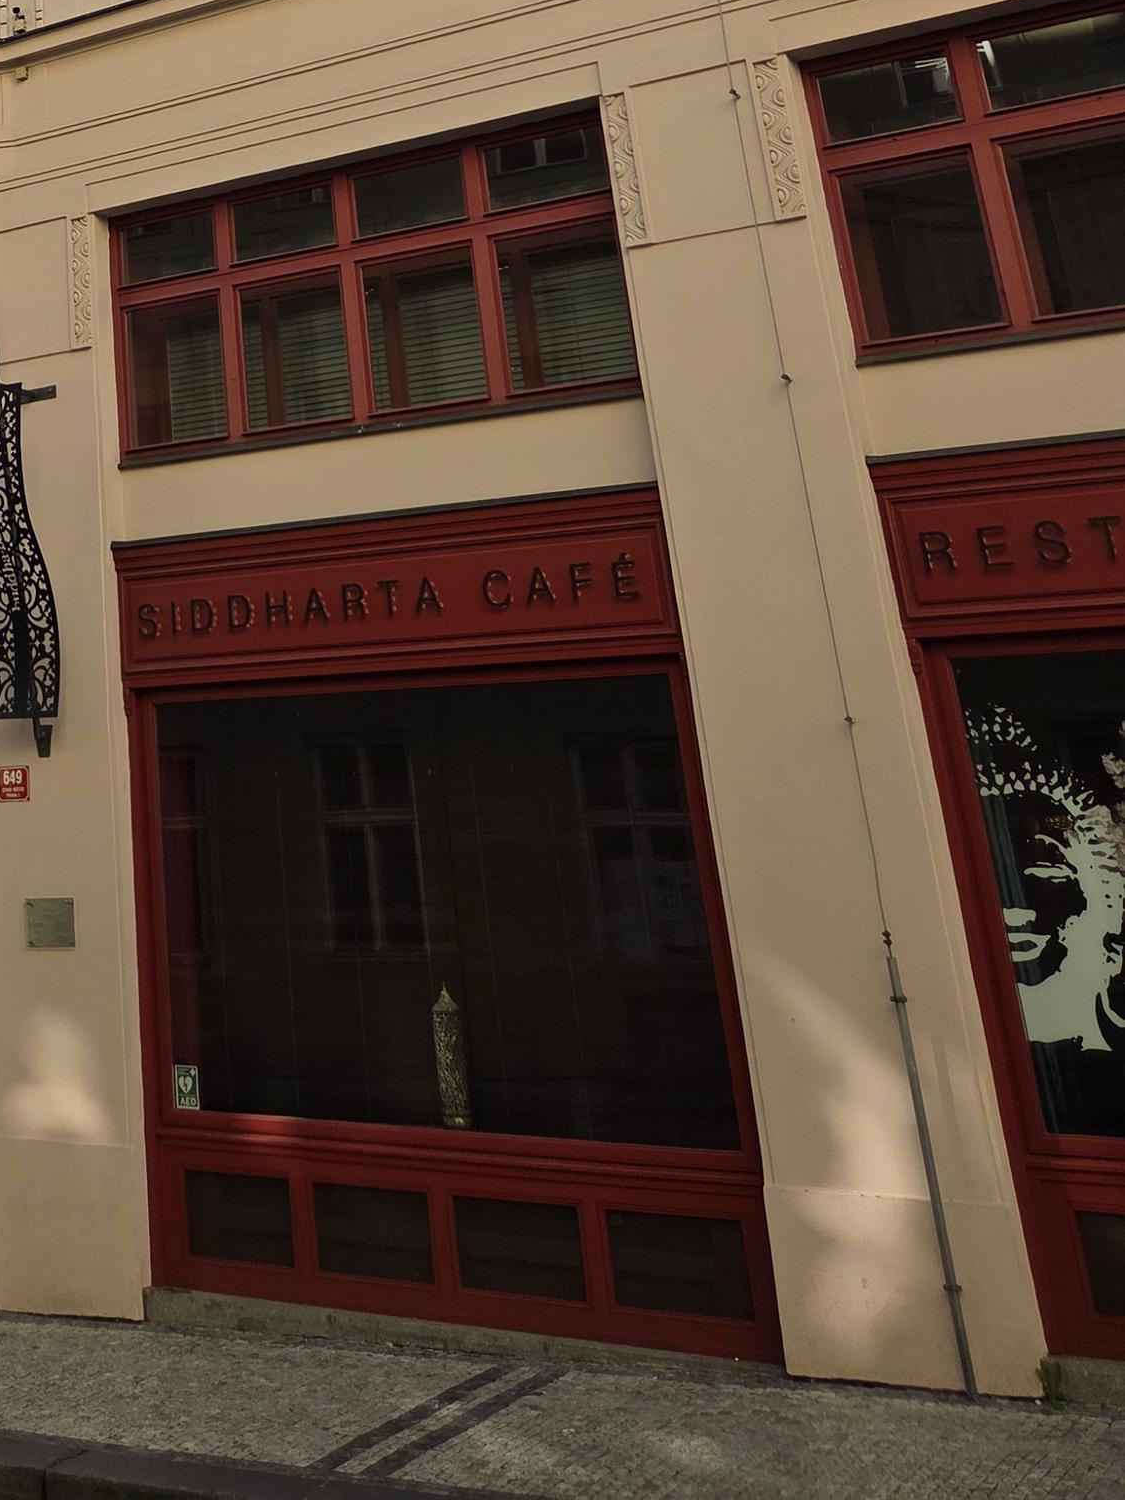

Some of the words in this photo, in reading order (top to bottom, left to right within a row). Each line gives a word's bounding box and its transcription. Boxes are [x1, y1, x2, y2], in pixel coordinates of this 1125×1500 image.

[918, 515, 1121, 574] REST
[137, 576, 444, 640] SIDDHARTA
[481, 552, 641, 610] CAFÉ
[3, 770, 22, 785] 649
[180, 1097, 197, 1106] AED
